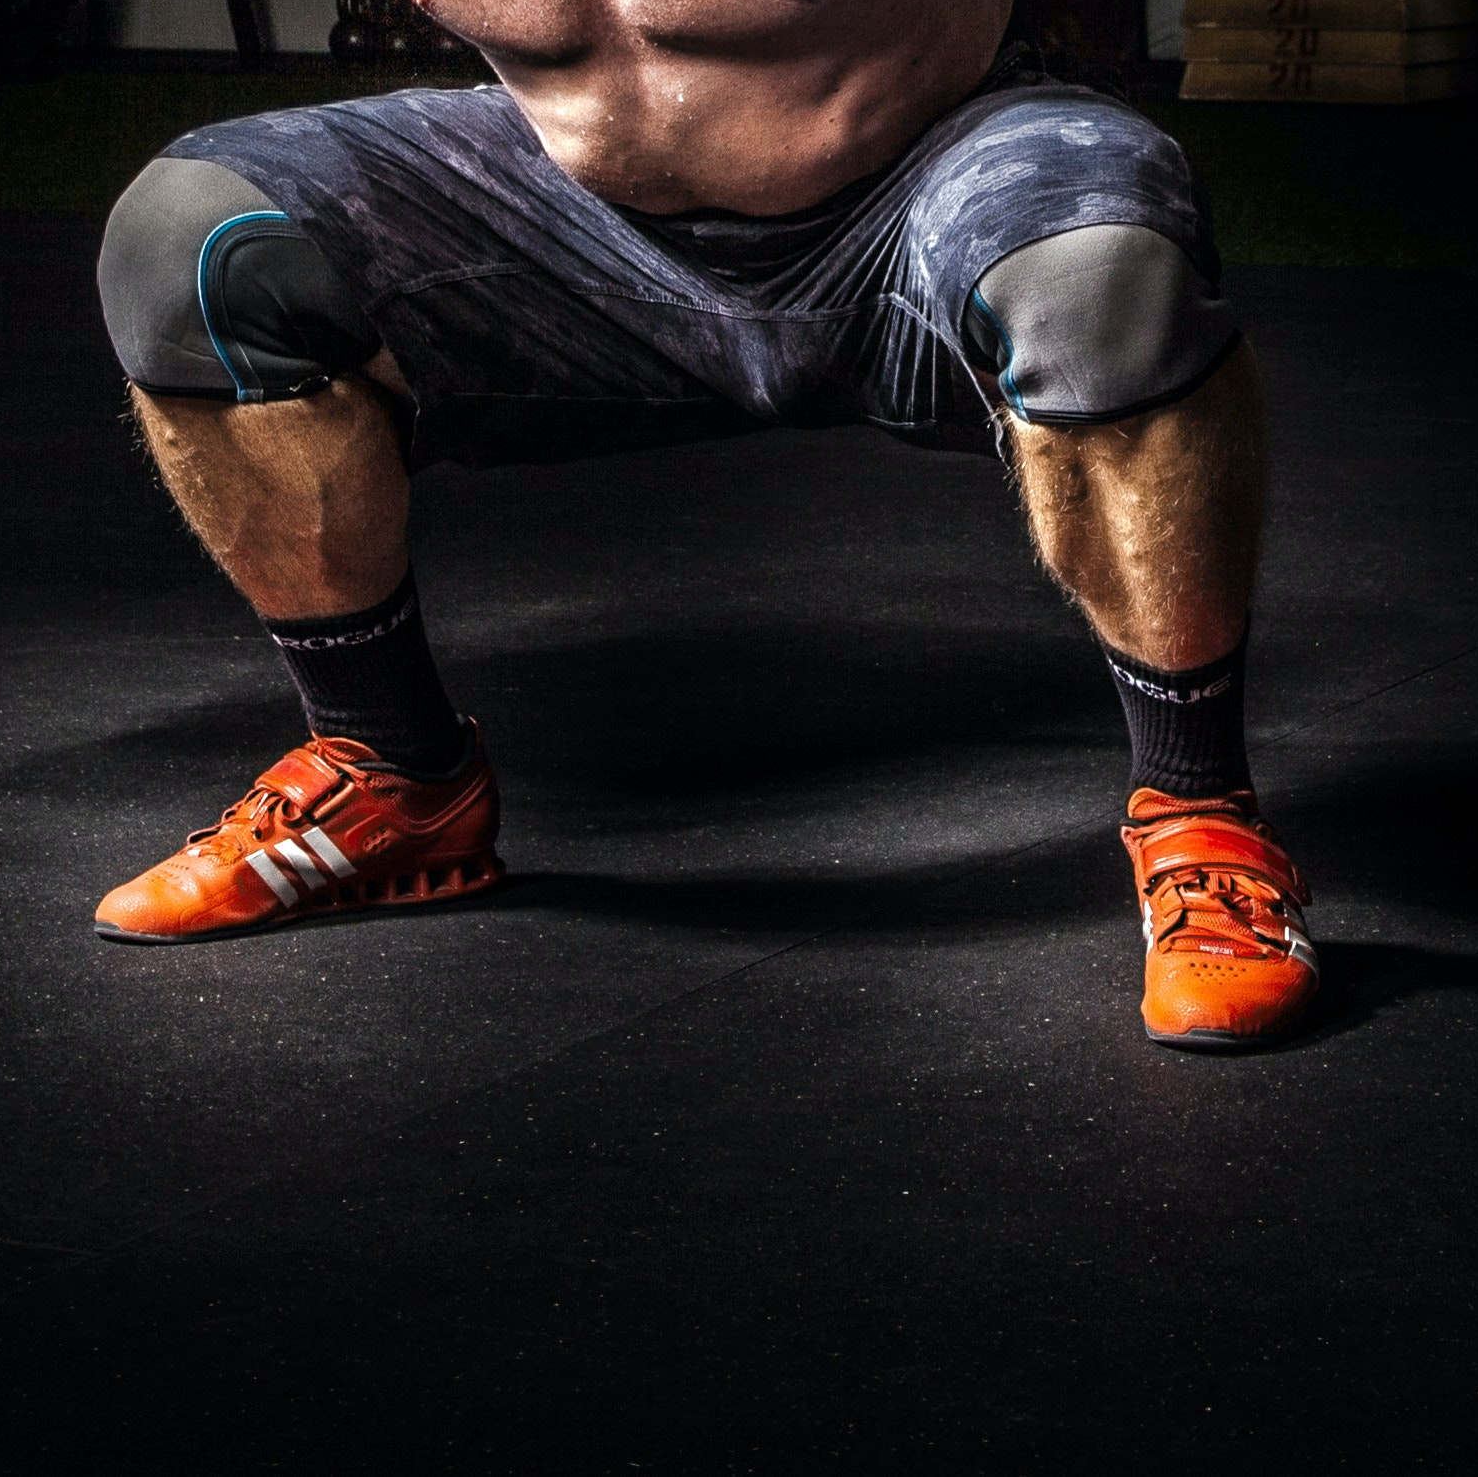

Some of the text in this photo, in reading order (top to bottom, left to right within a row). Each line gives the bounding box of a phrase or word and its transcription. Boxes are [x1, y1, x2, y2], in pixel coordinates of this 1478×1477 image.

[1276, 27, 1318, 56] 20
[1269, 63, 1311, 92] 20
[1108, 659, 1232, 705] OGUE
